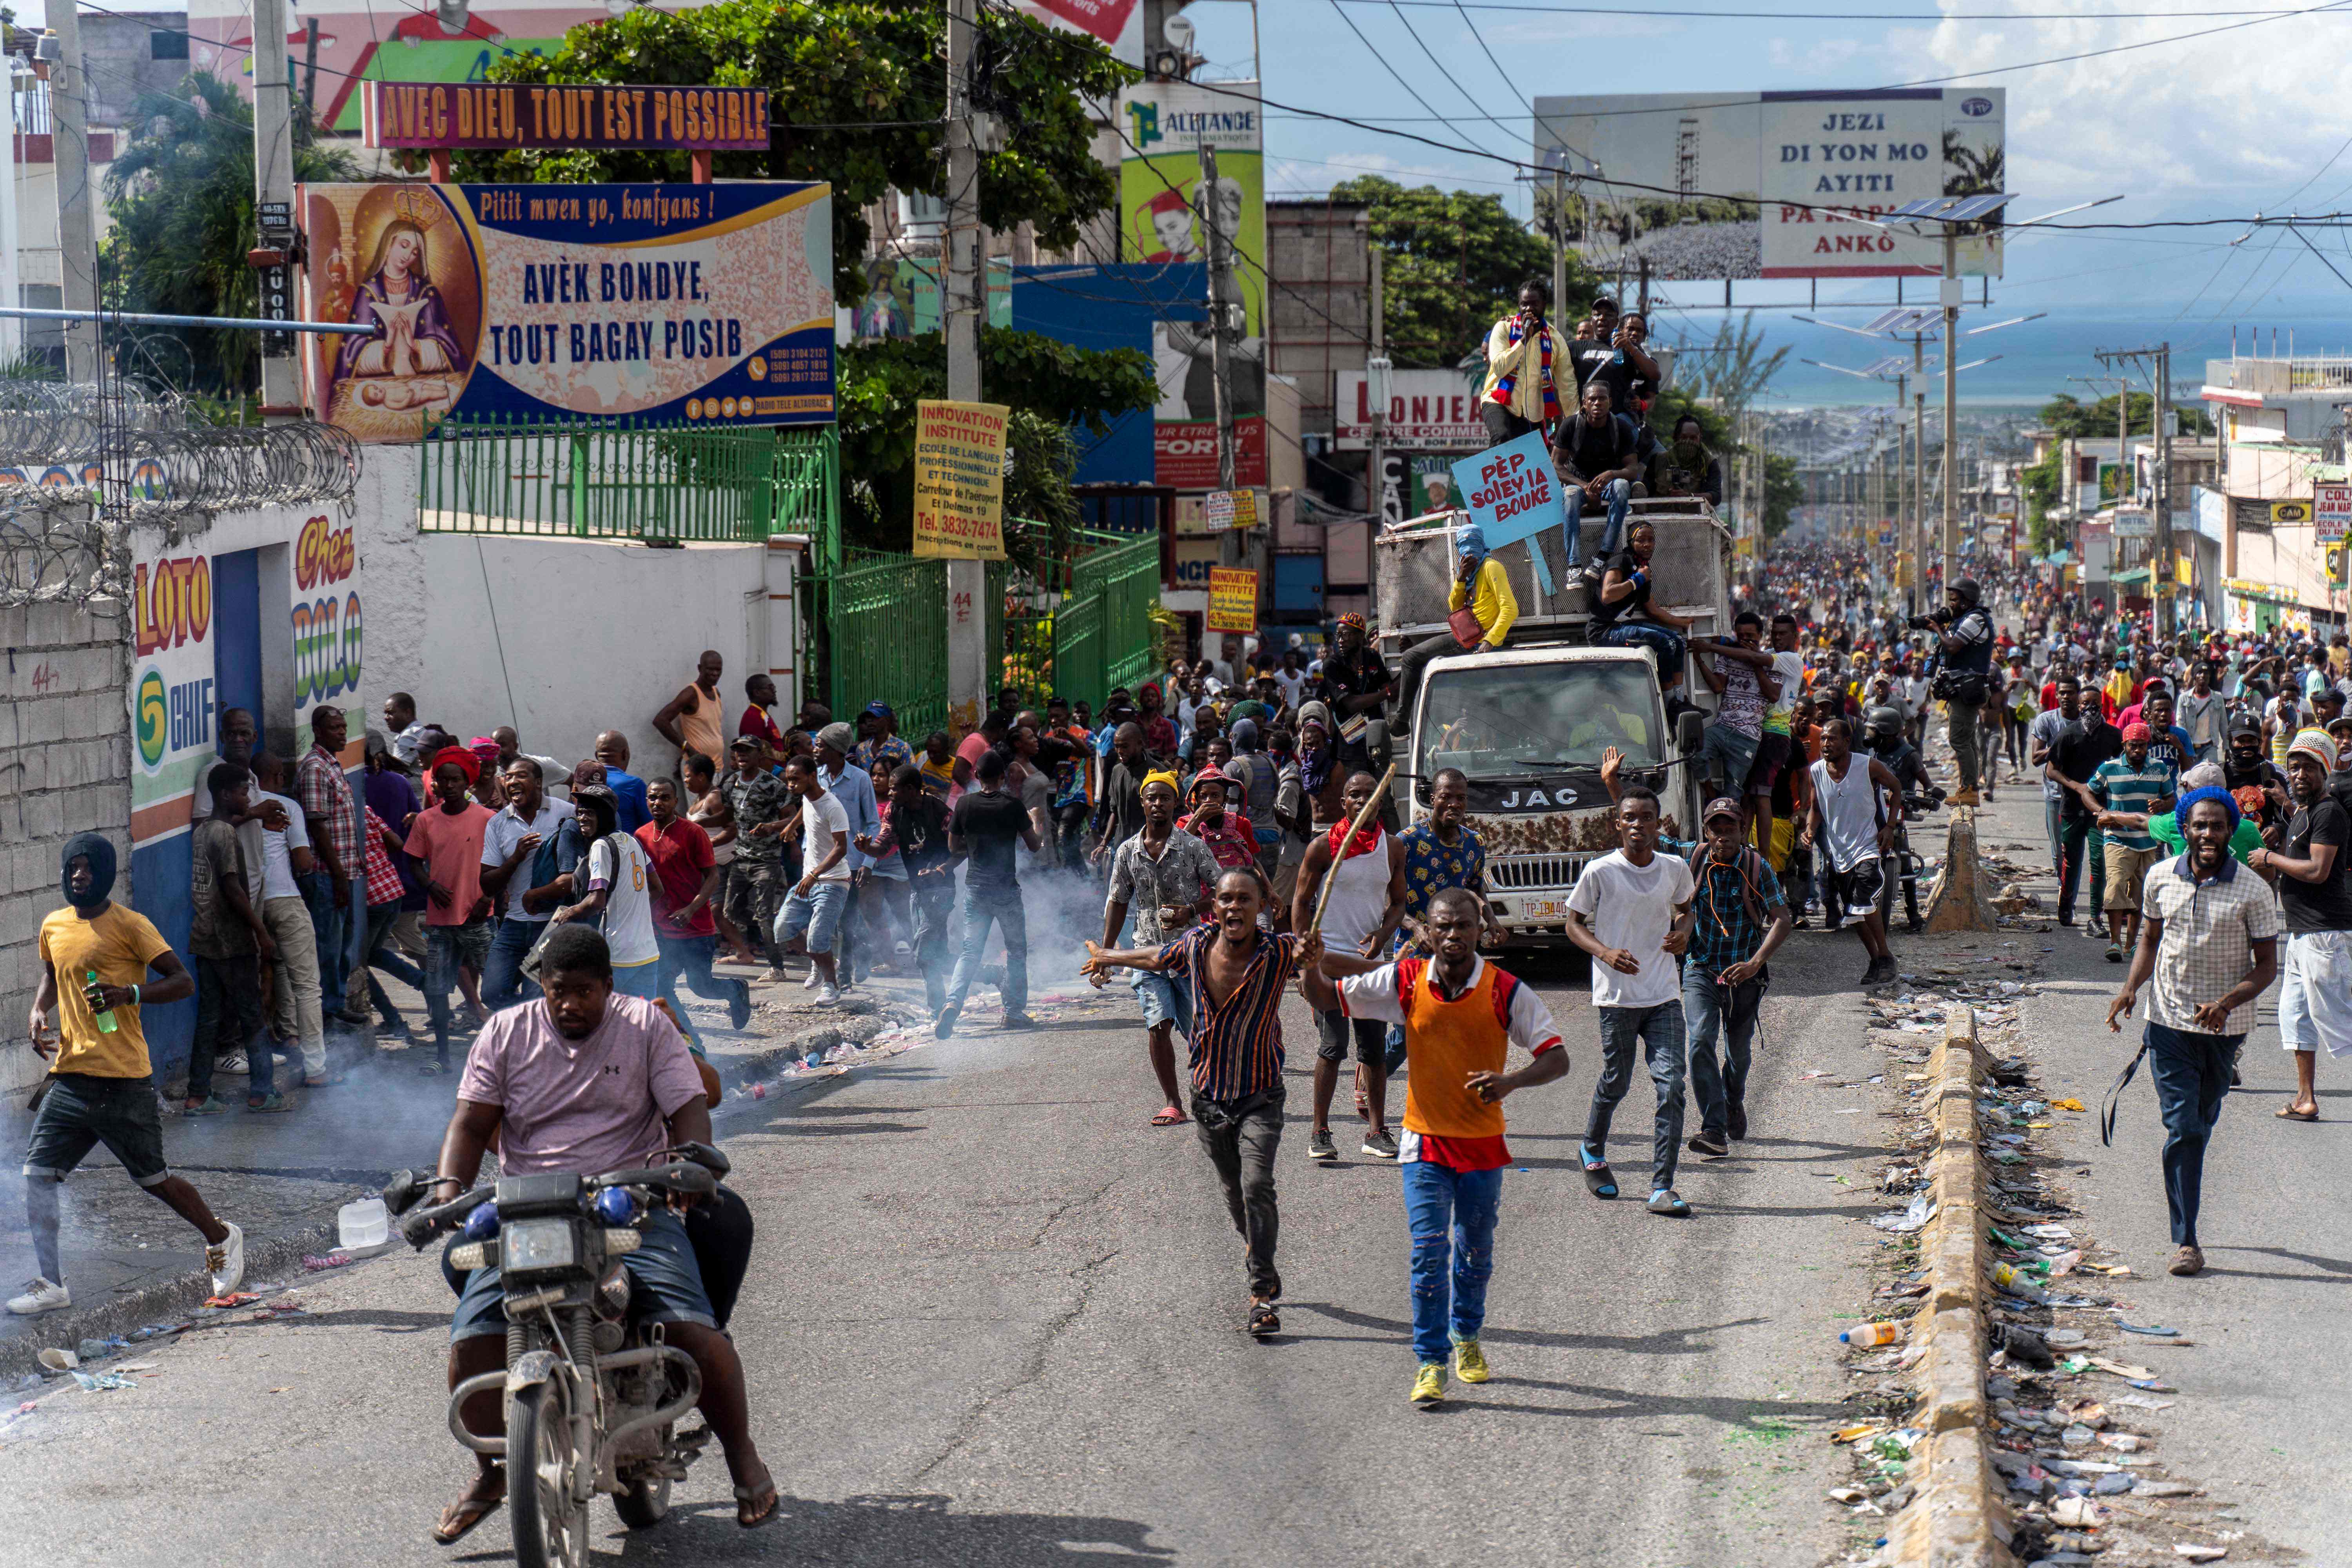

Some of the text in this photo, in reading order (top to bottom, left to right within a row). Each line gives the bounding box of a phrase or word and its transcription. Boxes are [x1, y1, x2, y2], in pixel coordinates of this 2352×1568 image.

[383, 87, 767, 144] AVEC DIEU, TOUT EST POSSIBLE
[1823, 114, 1885, 131] JEZI
[1780, 143, 1928, 162] DI YON MO
[1815, 174, 1894, 192] AYITI
[479, 188, 715, 227] Pitit mwen yo, konfyans !
[1781, 206, 1815, 223] PA
[1814, 231, 1895, 253] ANKÒ
[524, 256, 710, 304] AVÈK BONDYE,
[490, 319, 742, 365] TOUT BAGAY POSIB
[770, 348, 827, 359] (509) 3104 2121
[770, 360, 828, 371] (509) 4057 1818
[770, 373, 790, 383] (509)
[810, 372, 828, 381] 2233
[756, 399, 828, 411] RADIO TELE ALTAGRACE
[922, 407, 1004, 431] INNOVATION
[926, 424, 997, 447] INSTITUTE
[1349, 426, 1414, 437] CETRE
[919, 443, 1000, 463] ECOLE DE LANGUES
[920, 457, 998, 476] PROFESSIONNELLE
[1481, 453, 1525, 485] PÈP
[928, 470, 989, 487] ET TECHNIQUE
[918, 483, 998, 505] Carrefour de l'aéroport
[1495, 484, 1552, 523] BOUKE
[932, 499, 987, 516] Et Delmas 19
[2280, 508, 2301, 517] CAM
[918, 512, 998, 540] Tel. 3832-7474
[917, 533, 962, 548] Inscriptions
[296, 515, 354, 591] Chez
[1212, 571, 1257, 585] INNOVATION
[1212, 584, 1254, 595] INSTITUTE
[136, 555, 211, 657] LOTO
[292, 590, 363, 709] BOLO
[140, 678, 214, 760] 5 CHIF
[1502, 789, 1578, 808] JAC
[630, 850, 645, 892] 6
[1525, 902, 1566, 915] TP-18440
